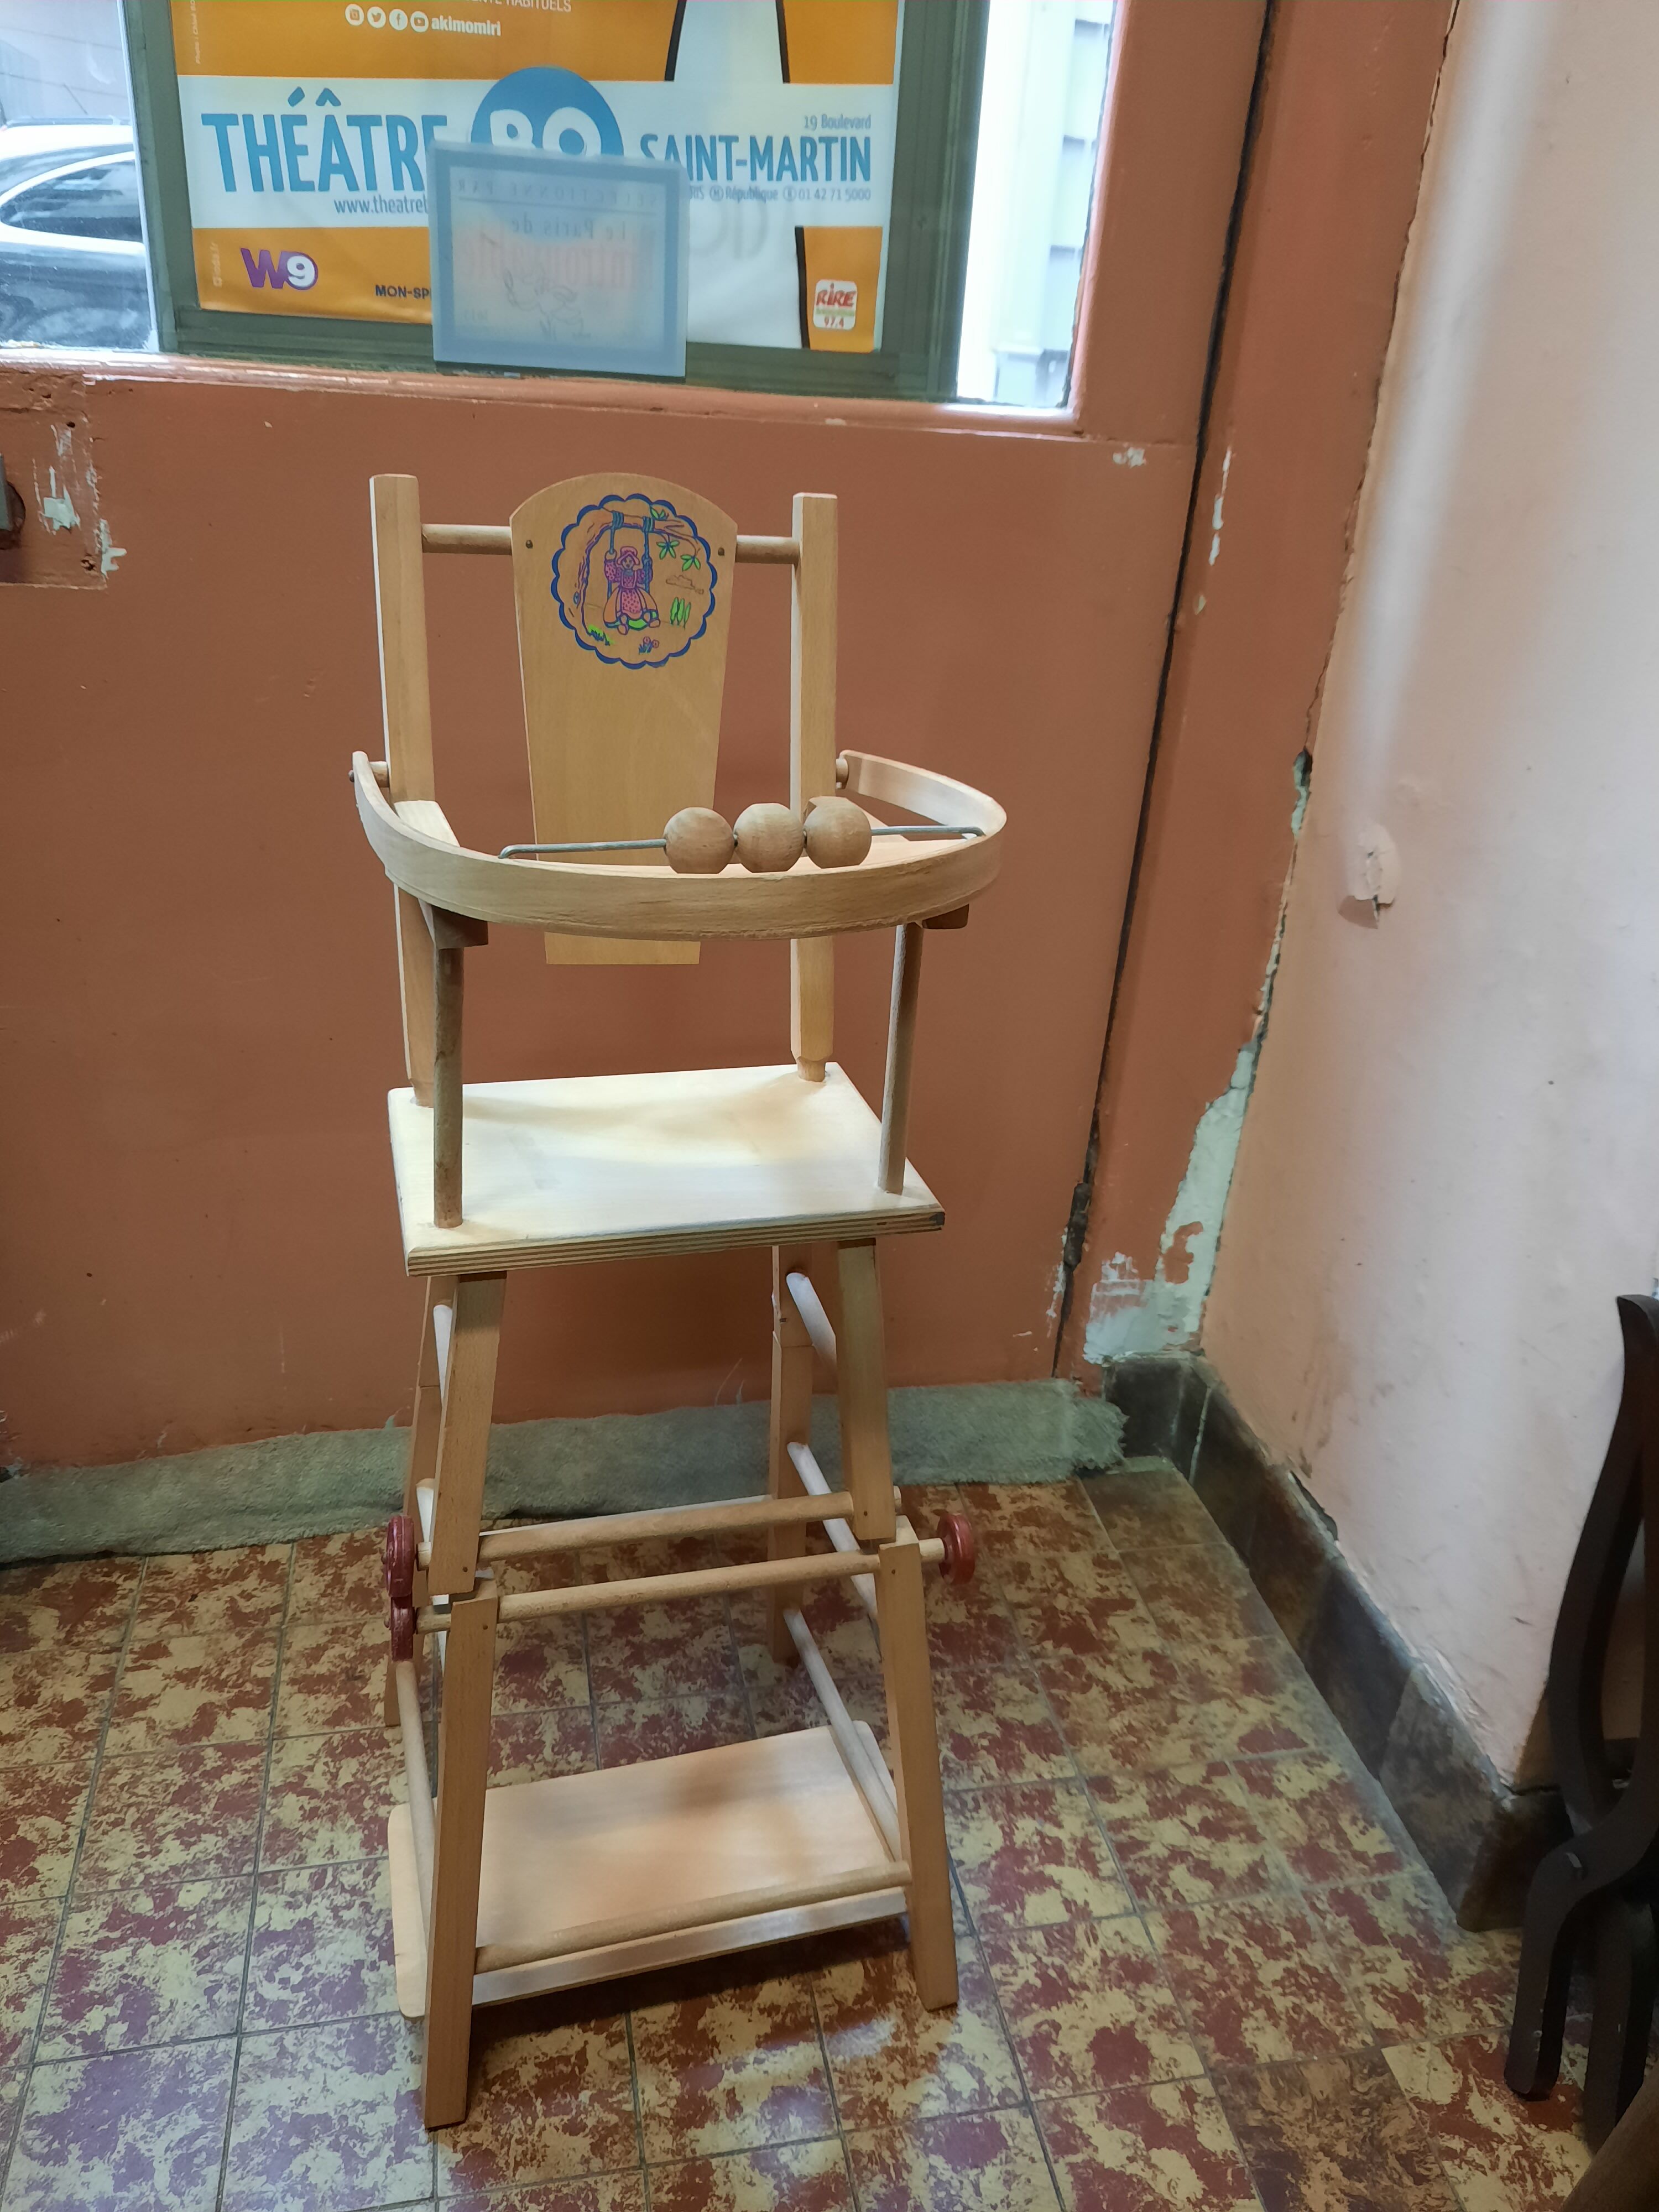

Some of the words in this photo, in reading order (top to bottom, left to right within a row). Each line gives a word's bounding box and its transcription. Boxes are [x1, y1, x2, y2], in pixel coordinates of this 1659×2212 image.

[431, 15, 501, 36] akimomiri
[821, 114, 872, 129] Boulevard
[640, 133, 871, 181] SAINT-MARTIN
[239, 247, 319, 290] W9
[375, 284, 431, 300] MON-SP
